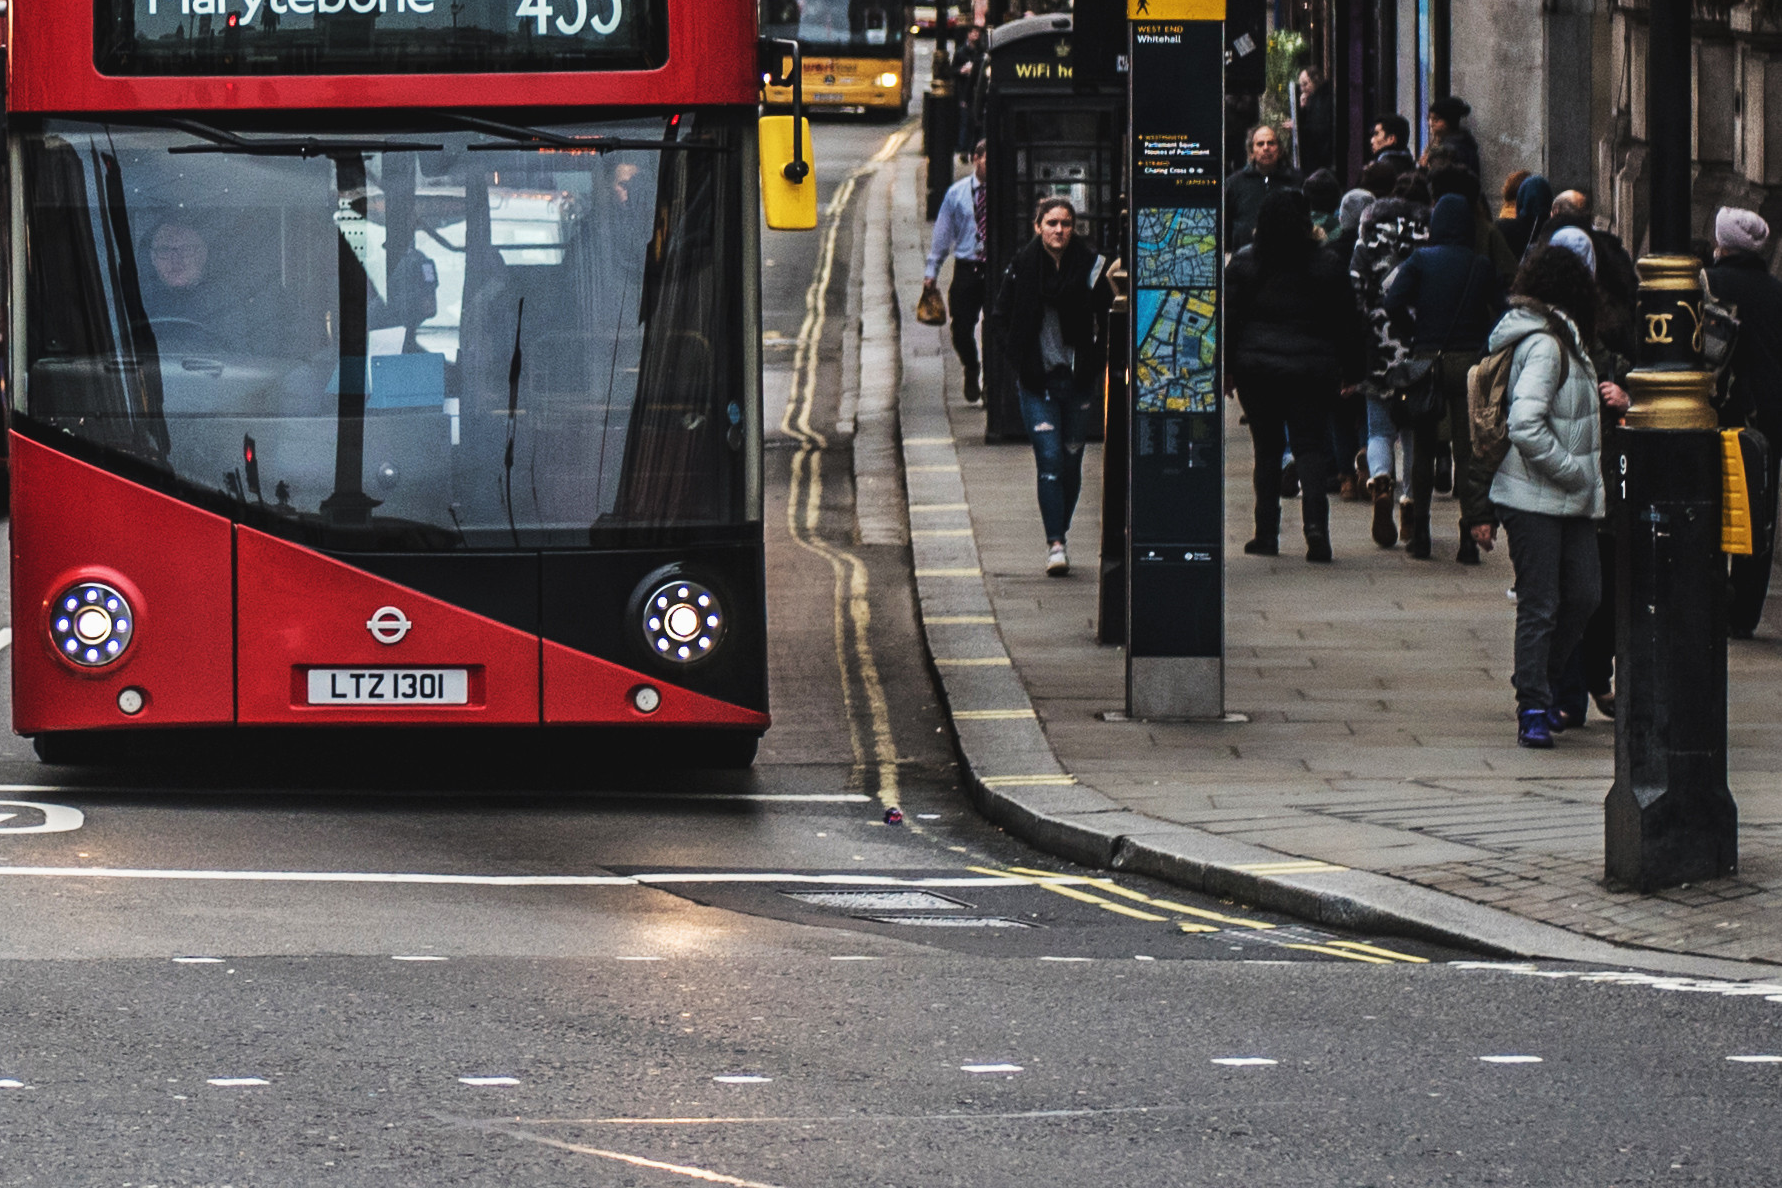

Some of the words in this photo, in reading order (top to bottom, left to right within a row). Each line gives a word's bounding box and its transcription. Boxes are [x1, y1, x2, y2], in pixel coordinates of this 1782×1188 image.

[1138, 25, 1161, 33] WEST
[1164, 25, 1184, 33] END
[1137, 34, 1181, 44] Whitehall
[1016, 63, 1050, 79] WiFi
[330, 673, 385, 699] LTZ
[392, 673, 444, 699] 1301
